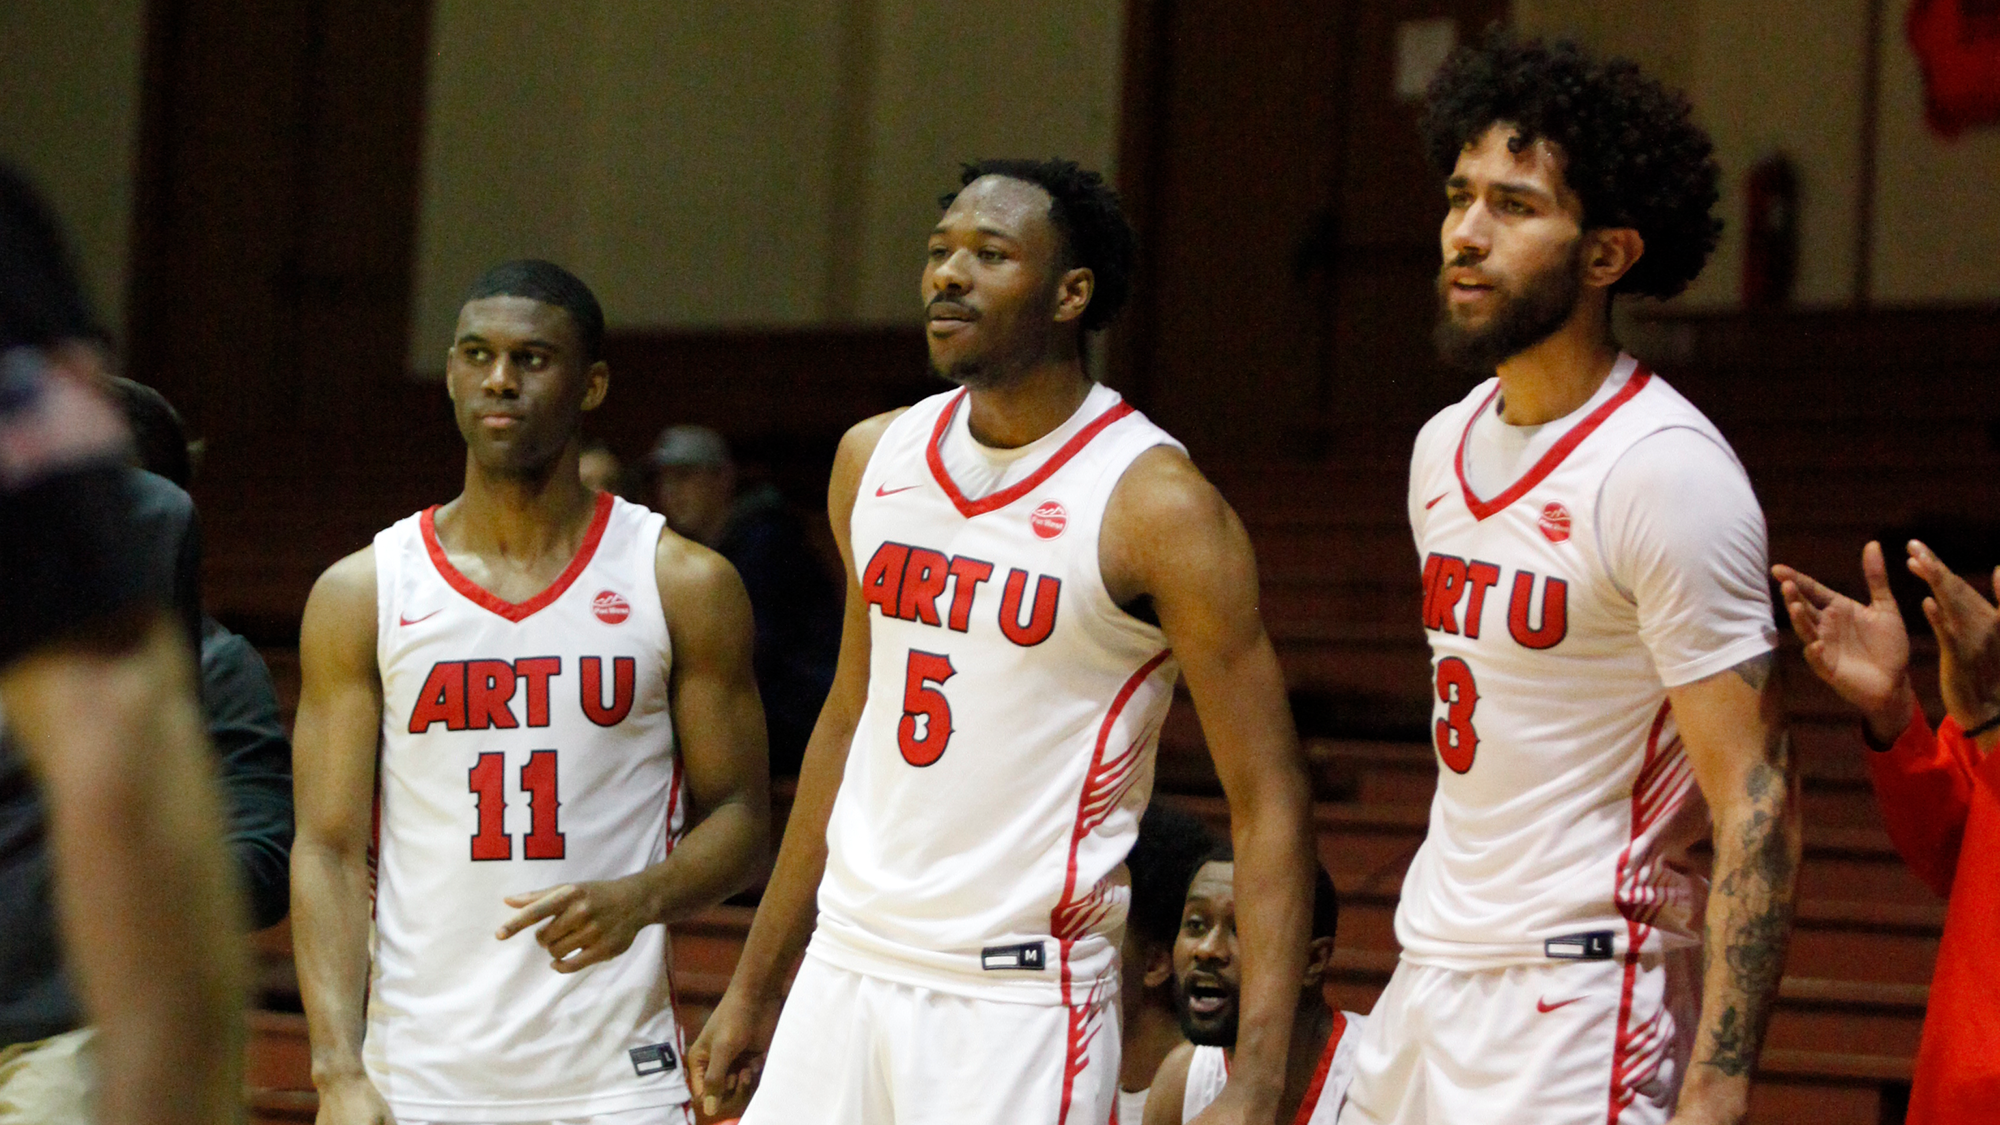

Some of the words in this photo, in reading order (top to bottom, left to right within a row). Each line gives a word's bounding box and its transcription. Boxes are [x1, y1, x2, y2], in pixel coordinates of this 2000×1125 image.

[862, 541, 994, 633] ART
[998, 567, 1062, 647] U
[1507, 569, 1568, 650] U
[408, 656, 562, 733] ART
[579, 656, 636, 727] U
[897, 648, 958, 768] 5
[1436, 656, 1481, 774] 3
[469, 749, 565, 862] 11
[1025, 949, 1037, 962] M
[1593, 938, 1602, 951] L
